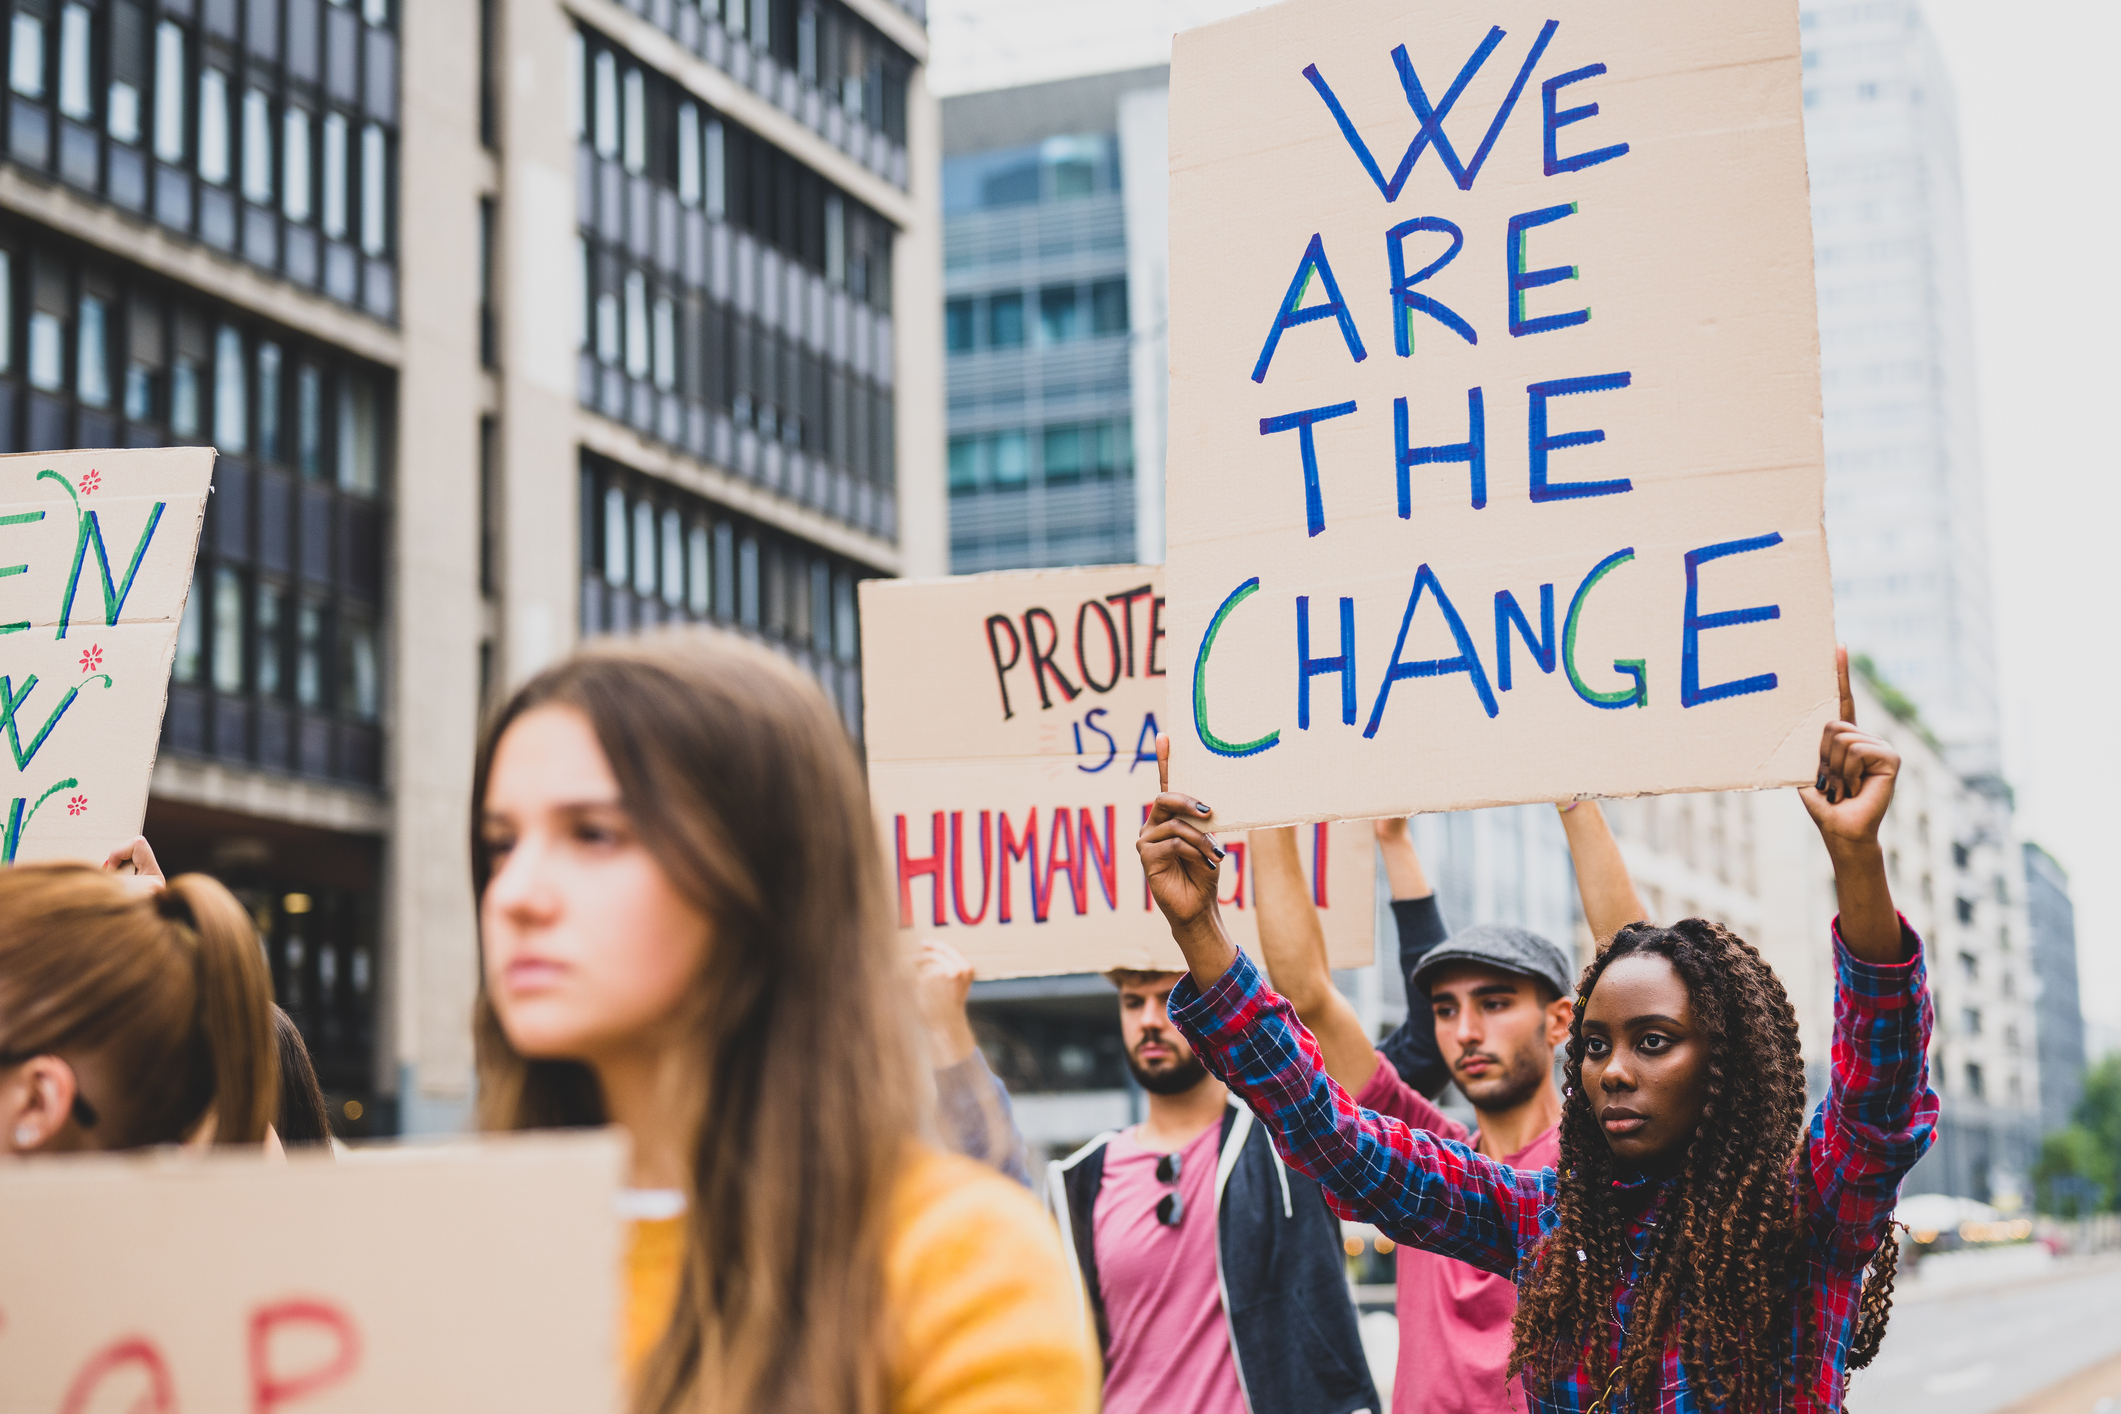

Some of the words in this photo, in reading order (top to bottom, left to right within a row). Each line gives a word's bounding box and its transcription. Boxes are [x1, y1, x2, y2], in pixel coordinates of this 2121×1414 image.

[1302, 19, 1630, 203] WE
[1251, 202, 1592, 384] ARE
[1260, 371, 1634, 538] THE
[1193, 532, 1784, 759] CHANGE
[1073, 708, 1117, 774] IS
[895, 804, 1118, 928] HUMAN
